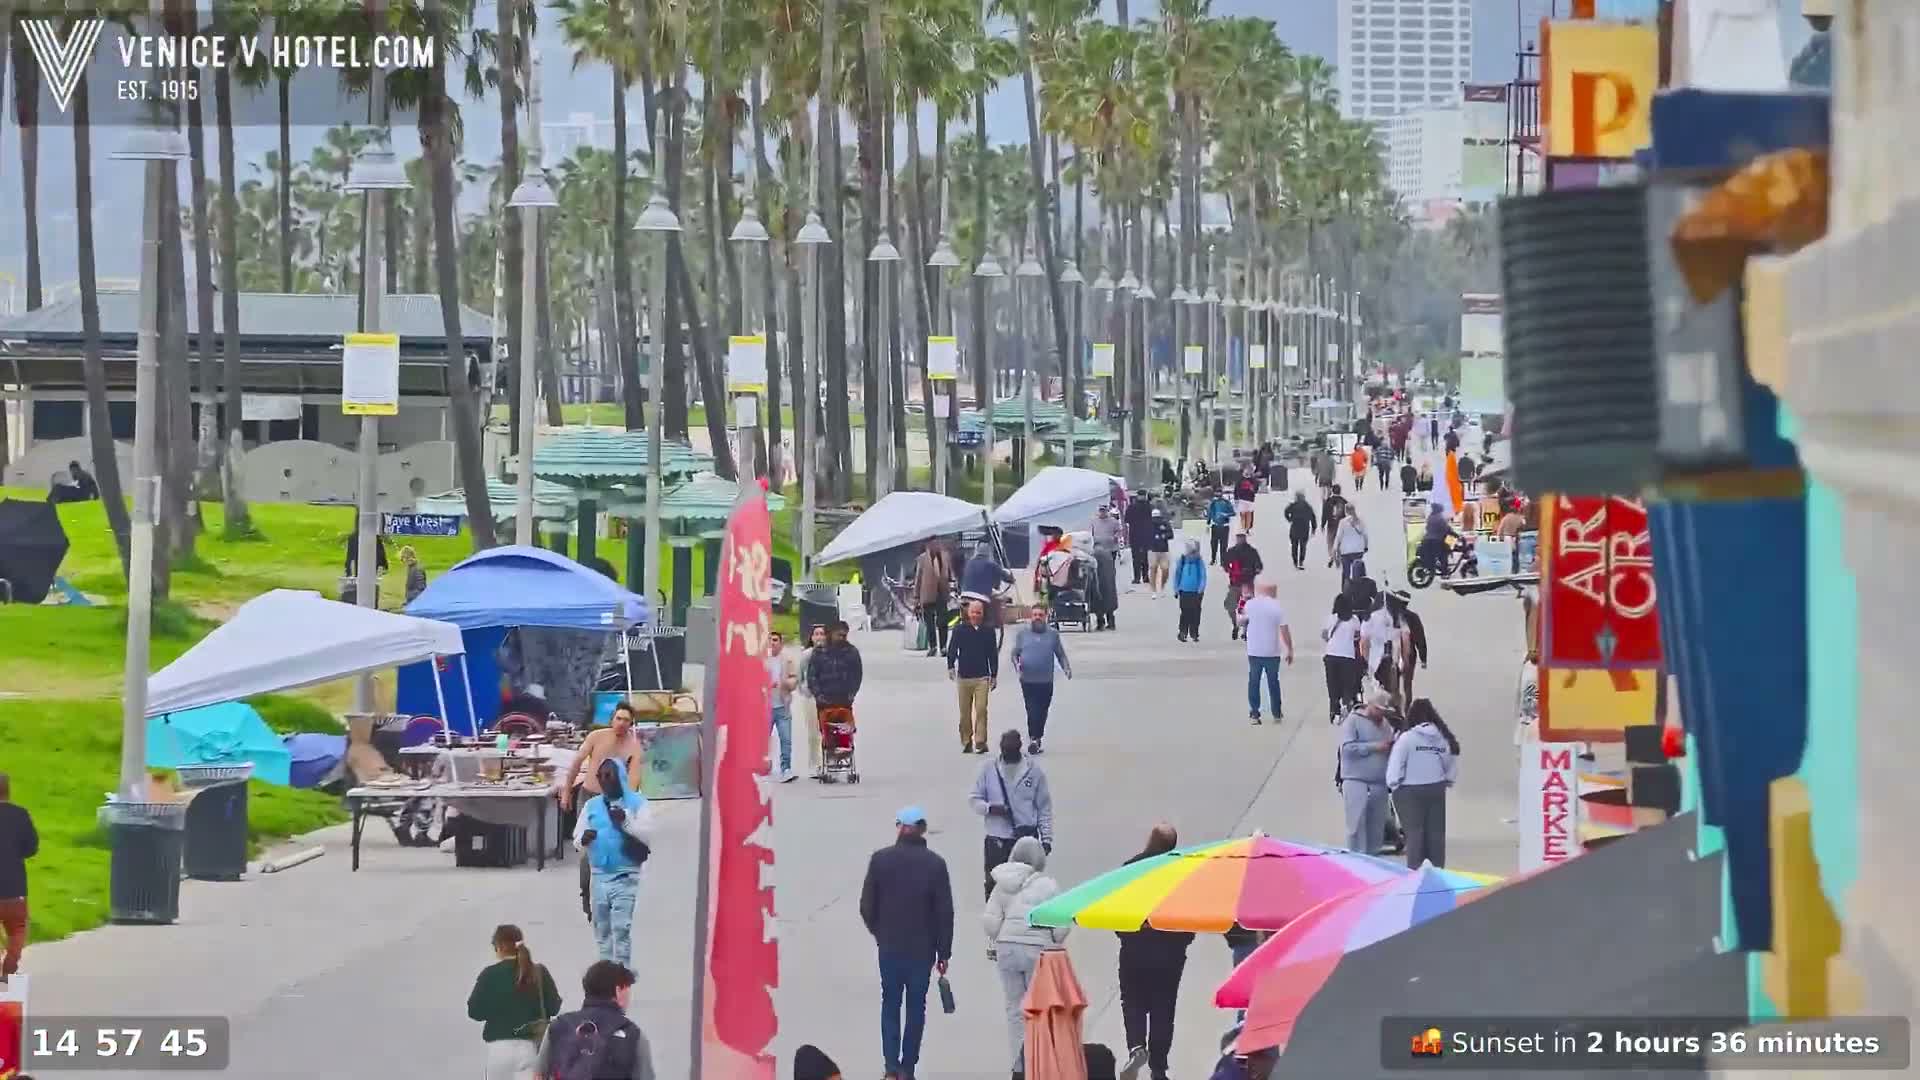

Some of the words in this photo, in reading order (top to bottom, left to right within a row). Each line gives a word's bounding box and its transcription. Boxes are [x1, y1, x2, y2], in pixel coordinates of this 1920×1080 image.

[415, 514, 442, 528] Crest
[1559, 495, 1607, 607] AR
[1540, 749, 1570, 862] MARKE
